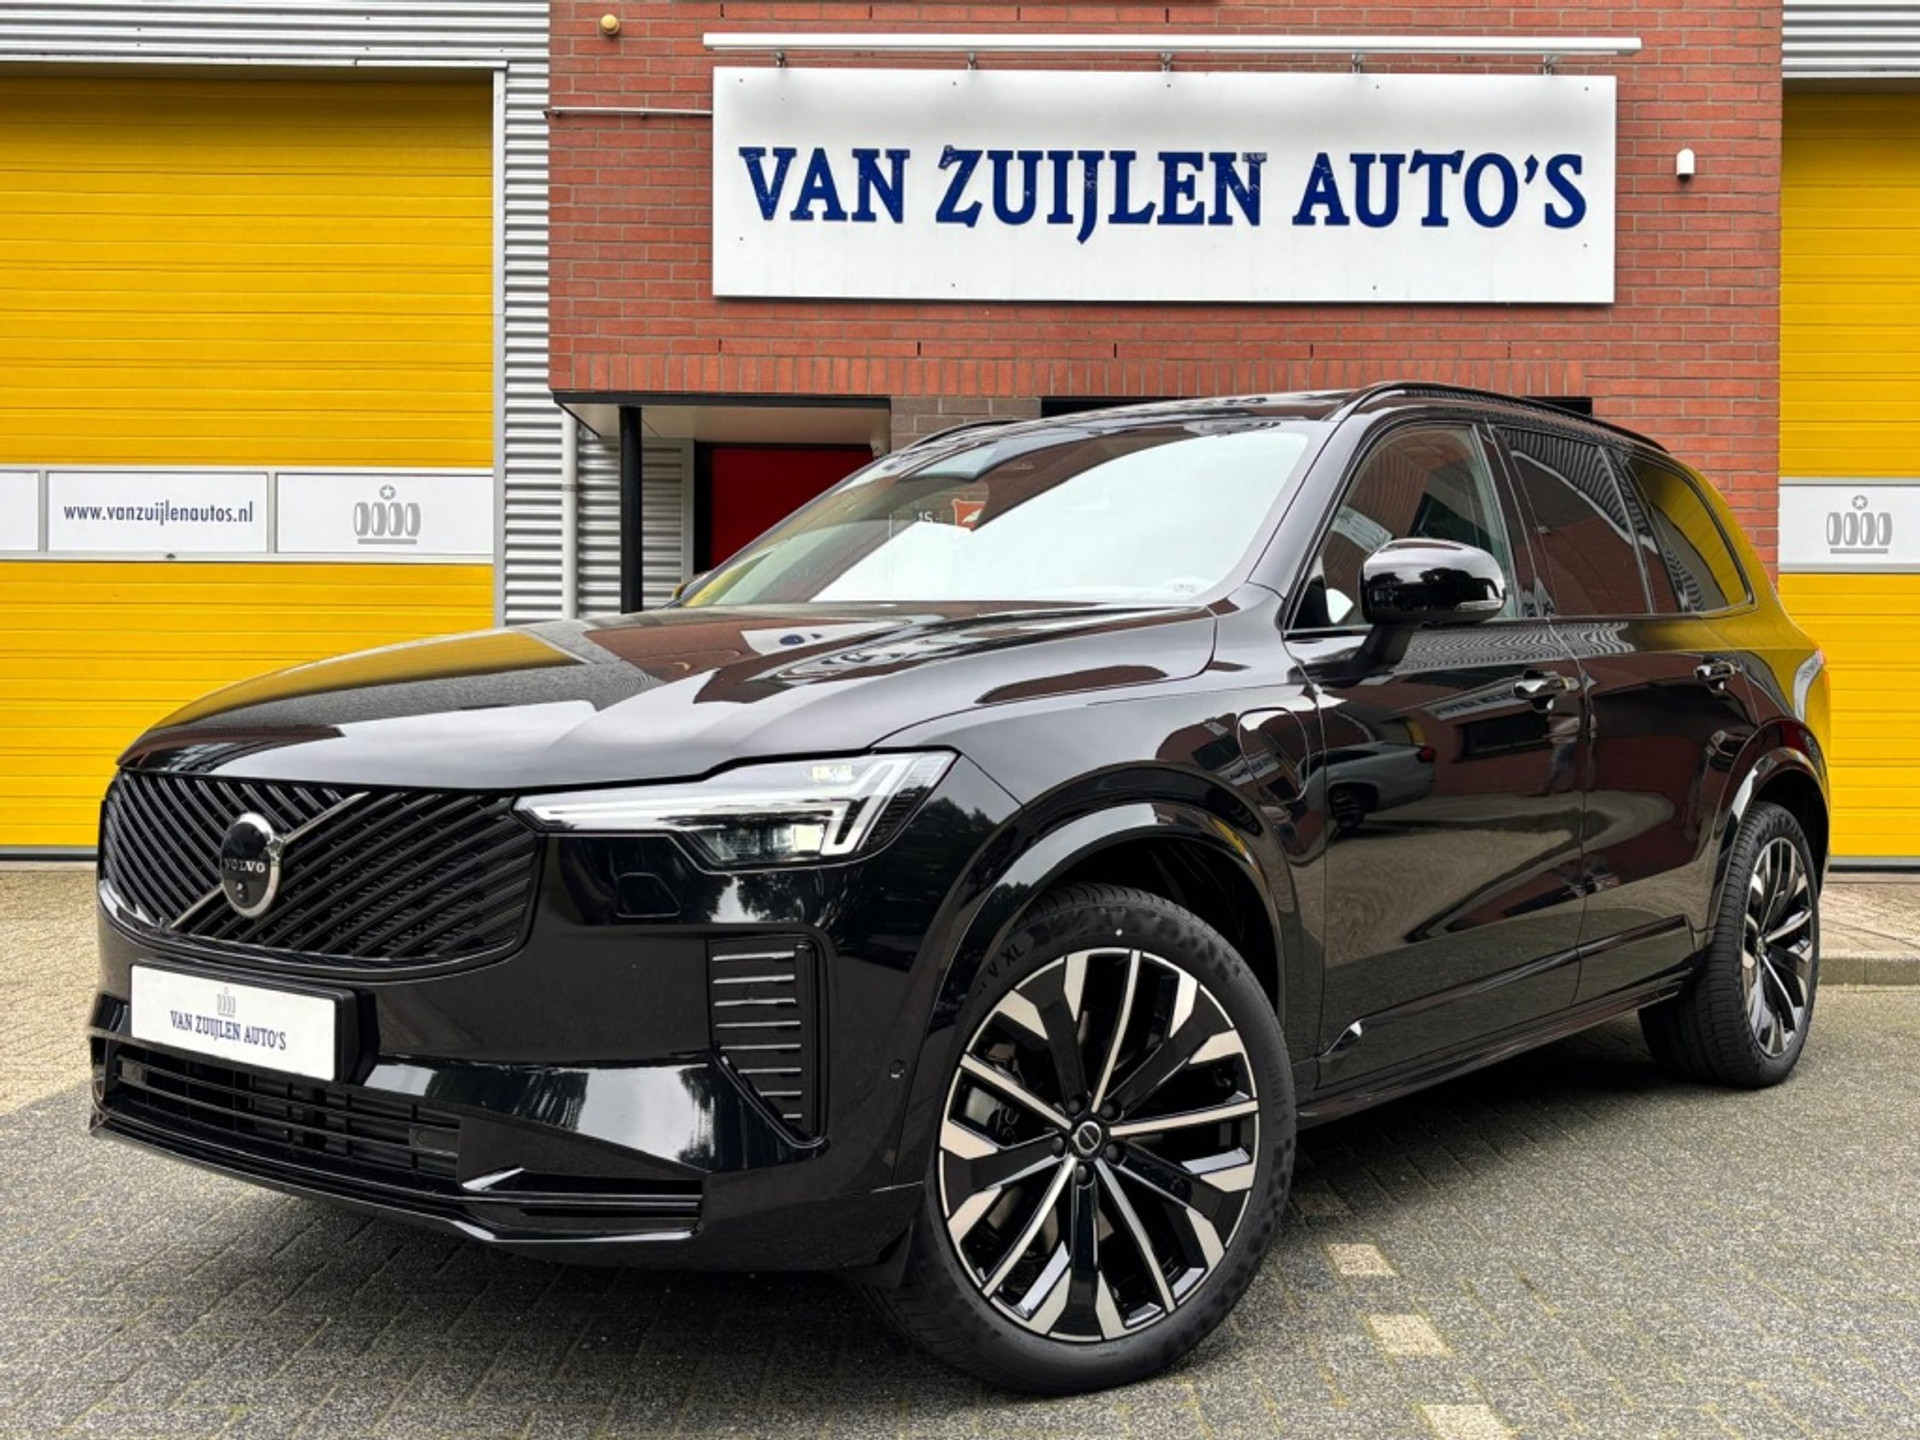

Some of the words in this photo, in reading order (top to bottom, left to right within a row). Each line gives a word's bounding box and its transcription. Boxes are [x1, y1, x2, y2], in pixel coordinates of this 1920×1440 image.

[738, 146, 911, 224] VAN
[935, 144, 1267, 245] ZUIJLEN
[1292, 149, 1587, 229] AUTO'S
[63, 499, 254, 526] www.vanzuijlenautos.nl
[223, 857, 266, 873] VOLVO
[170, 1010, 193, 1032] VAN
[195, 1016, 241, 1041] ZUIJLEN
[243, 1025, 287, 1051] AUTO'S
